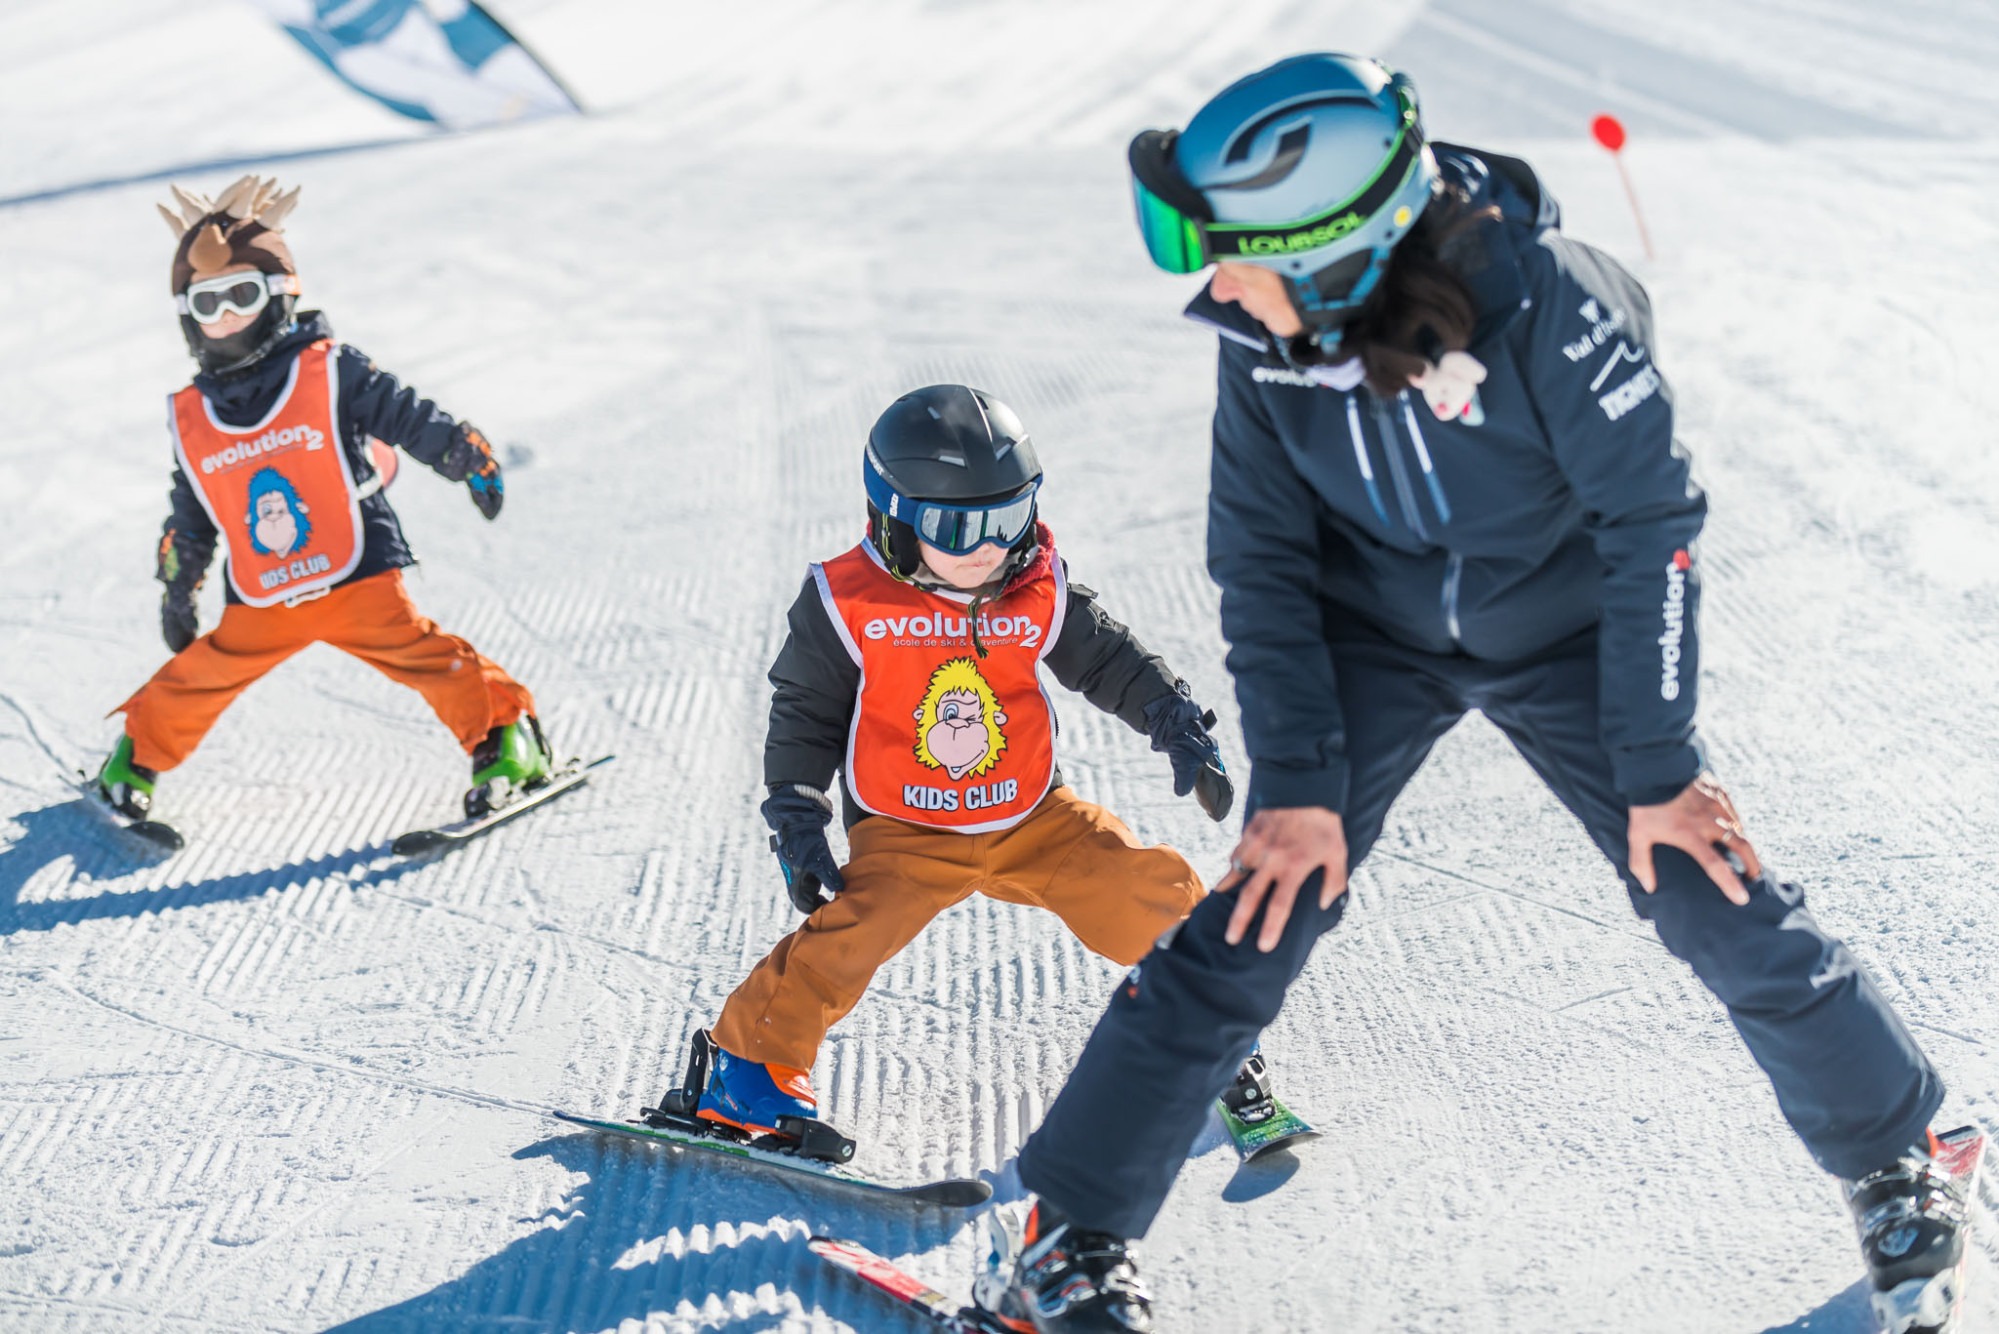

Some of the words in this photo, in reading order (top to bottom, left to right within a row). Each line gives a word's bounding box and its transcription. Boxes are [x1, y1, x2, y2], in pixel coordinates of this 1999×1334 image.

[260, 566, 290, 590] IDS
[290, 553, 331, 579] CLUB
[893, 637, 921, 647] école
[923, 638, 937, 647] de
[940, 638, 956, 647] ski
[959, 638, 967, 647] &
[903, 785, 959, 812] KIDS
[964, 778, 1018, 810] CLUB
